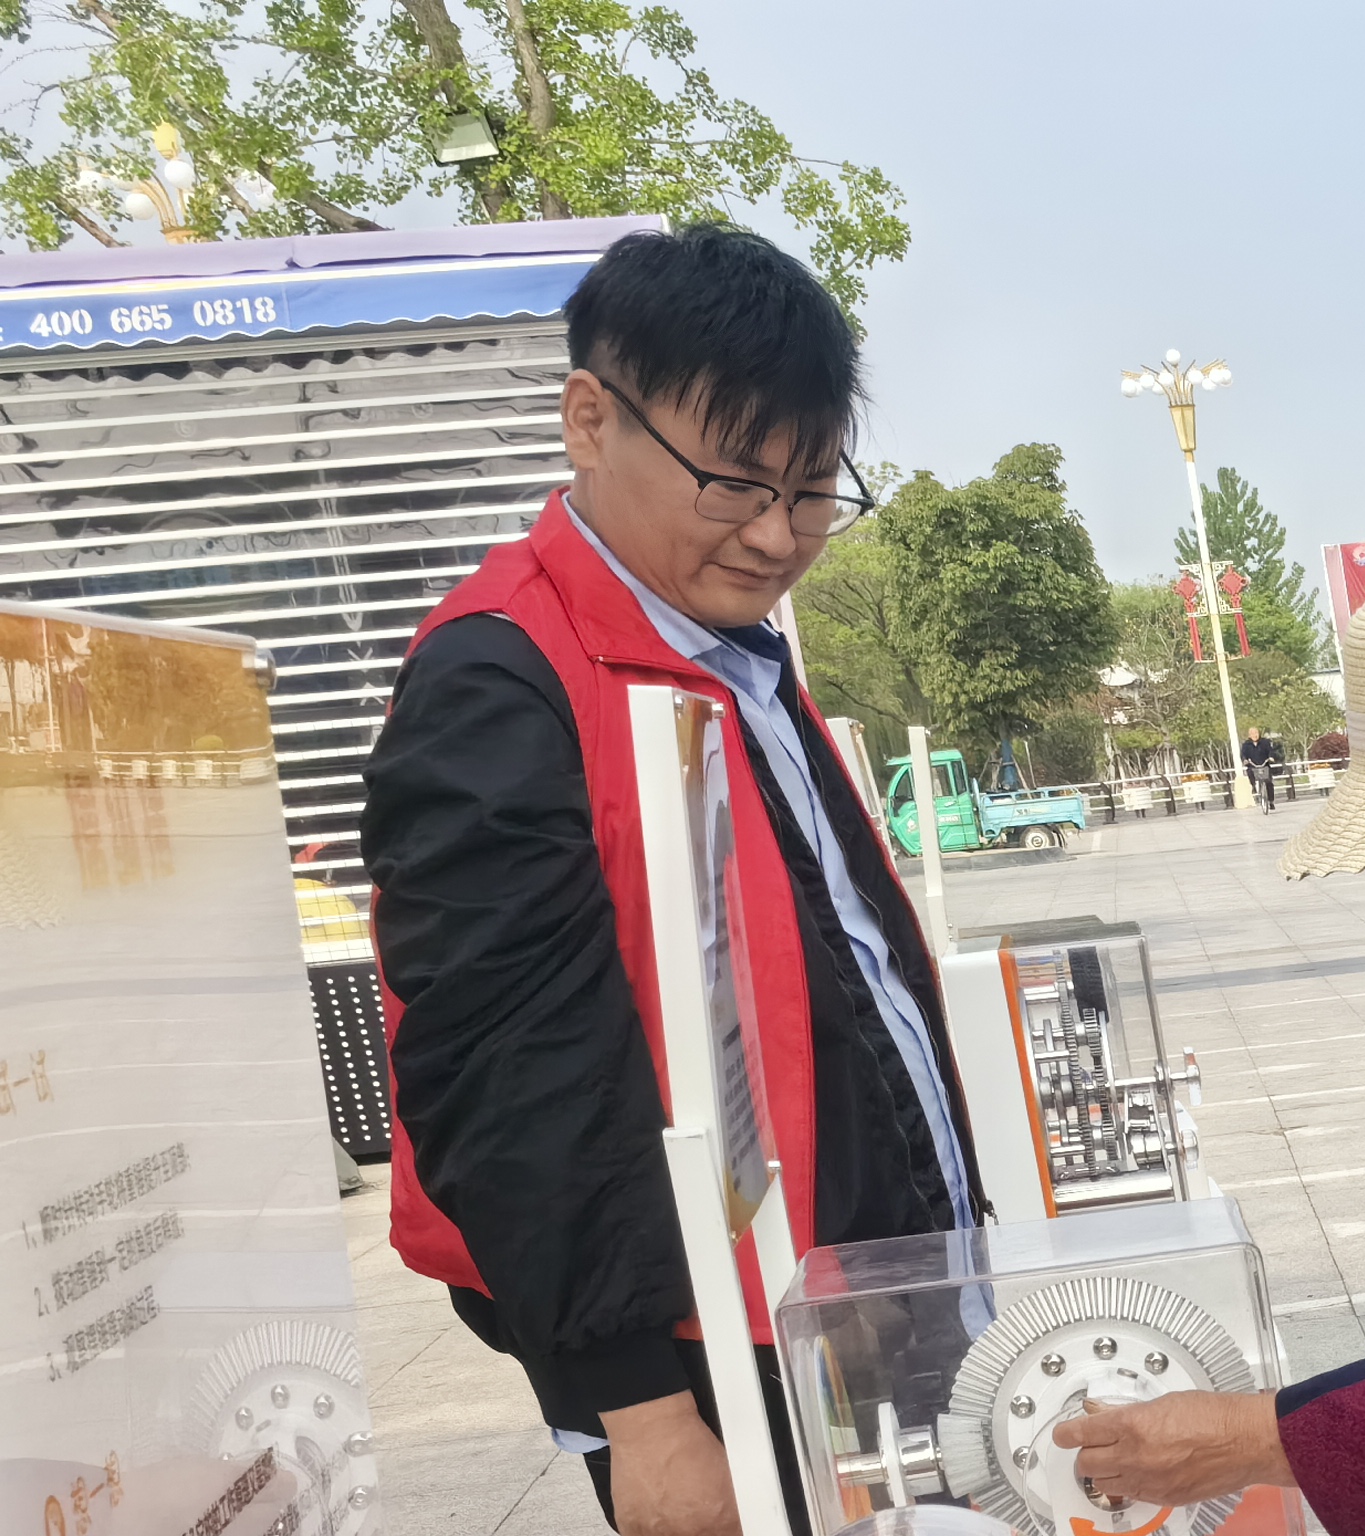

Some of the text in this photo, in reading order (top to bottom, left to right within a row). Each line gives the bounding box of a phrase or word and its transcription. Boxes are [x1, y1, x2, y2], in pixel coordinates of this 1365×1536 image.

[29, 296, 278, 338] 400 665 0818
